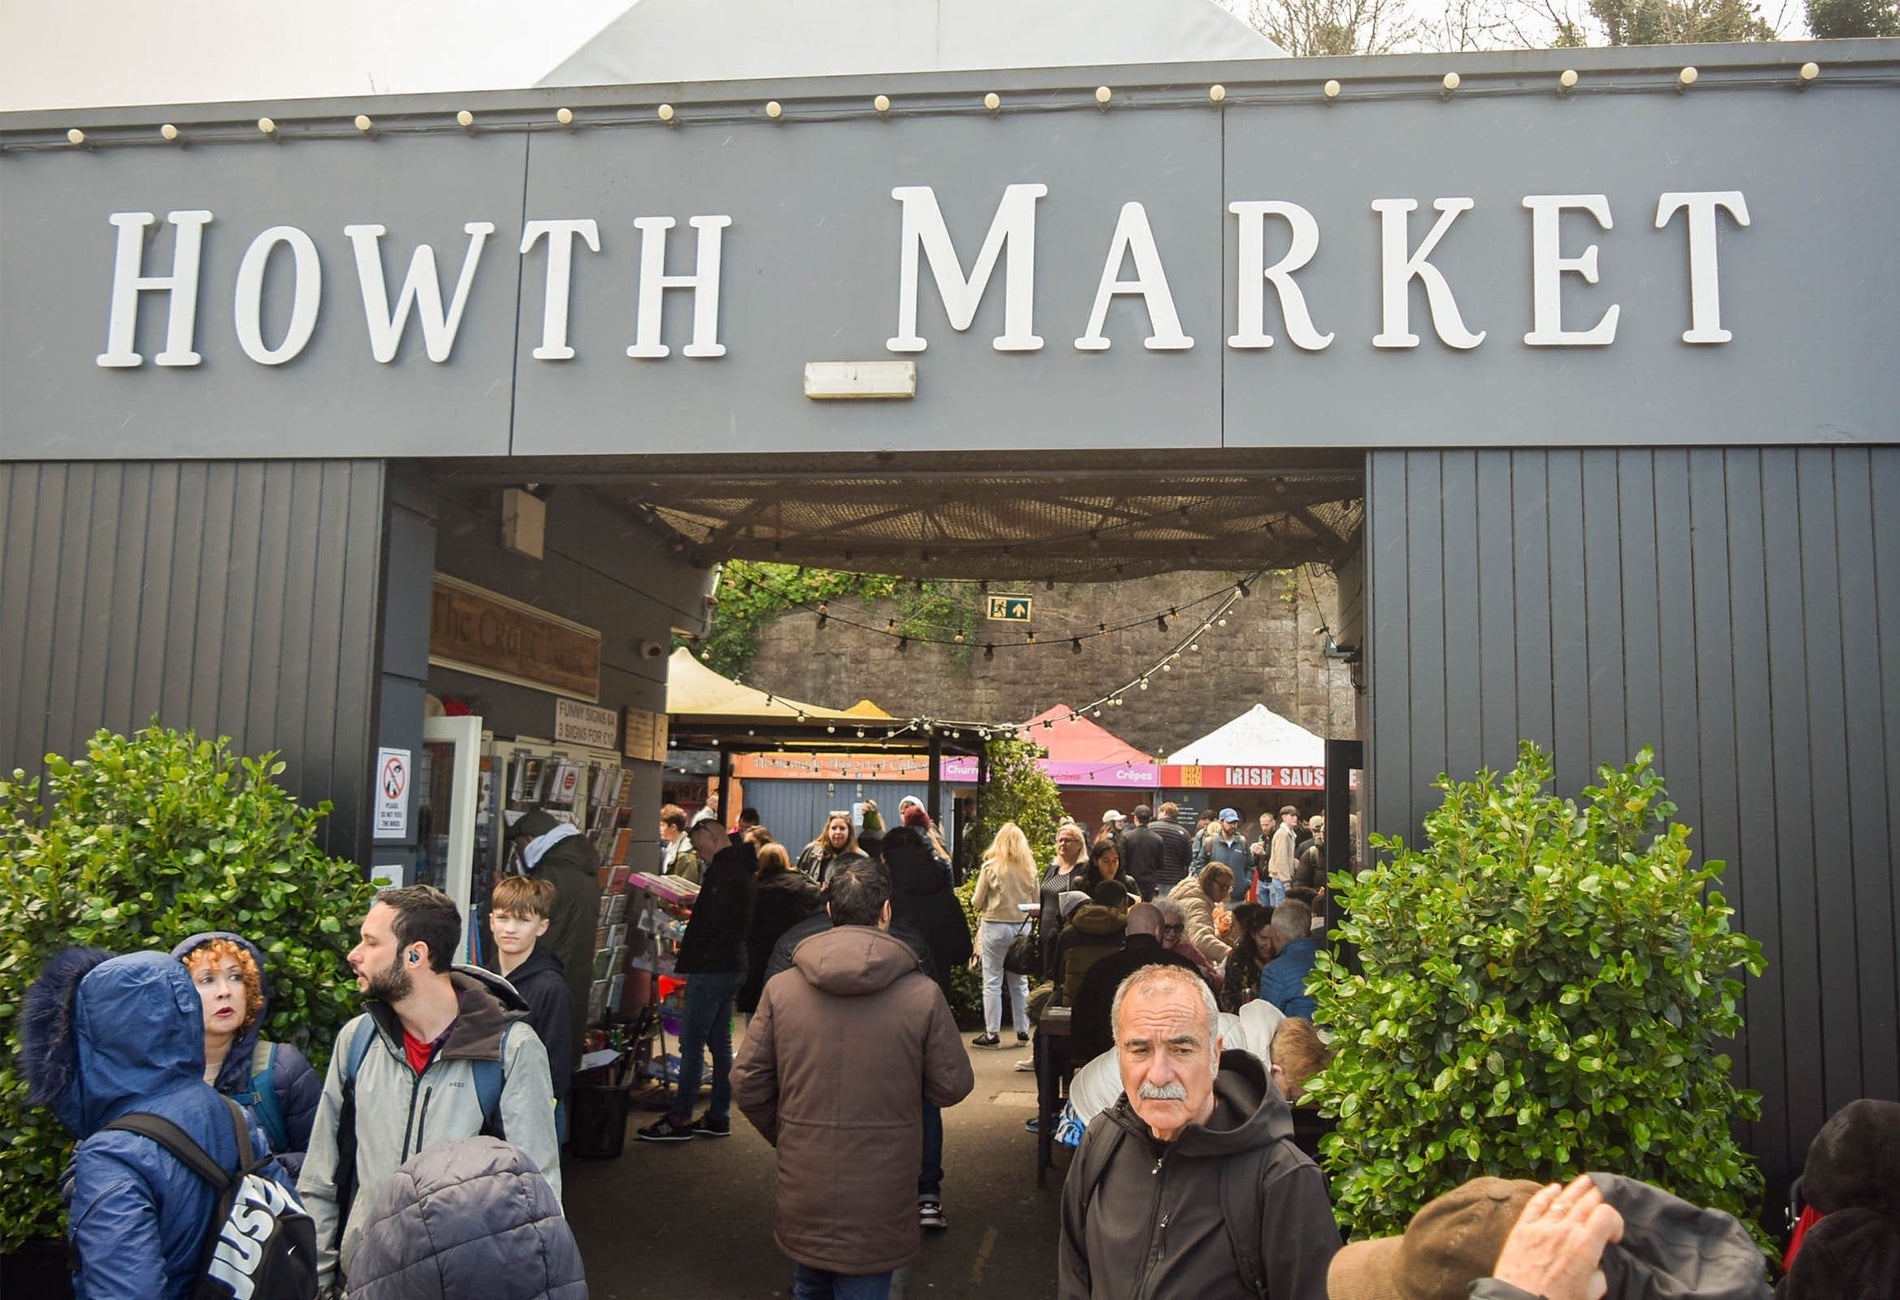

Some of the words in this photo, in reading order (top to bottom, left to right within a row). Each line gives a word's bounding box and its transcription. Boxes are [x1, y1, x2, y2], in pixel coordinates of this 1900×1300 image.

[97, 209, 733, 369] HOWTH
[886, 183, 1752, 354] MARKET
[560, 702, 585, 719] FUNNY
[586, 708, 607, 725] SIGNS
[564, 723, 588, 741] SIGNS
[1225, 767, 1273, 786] IRISH
